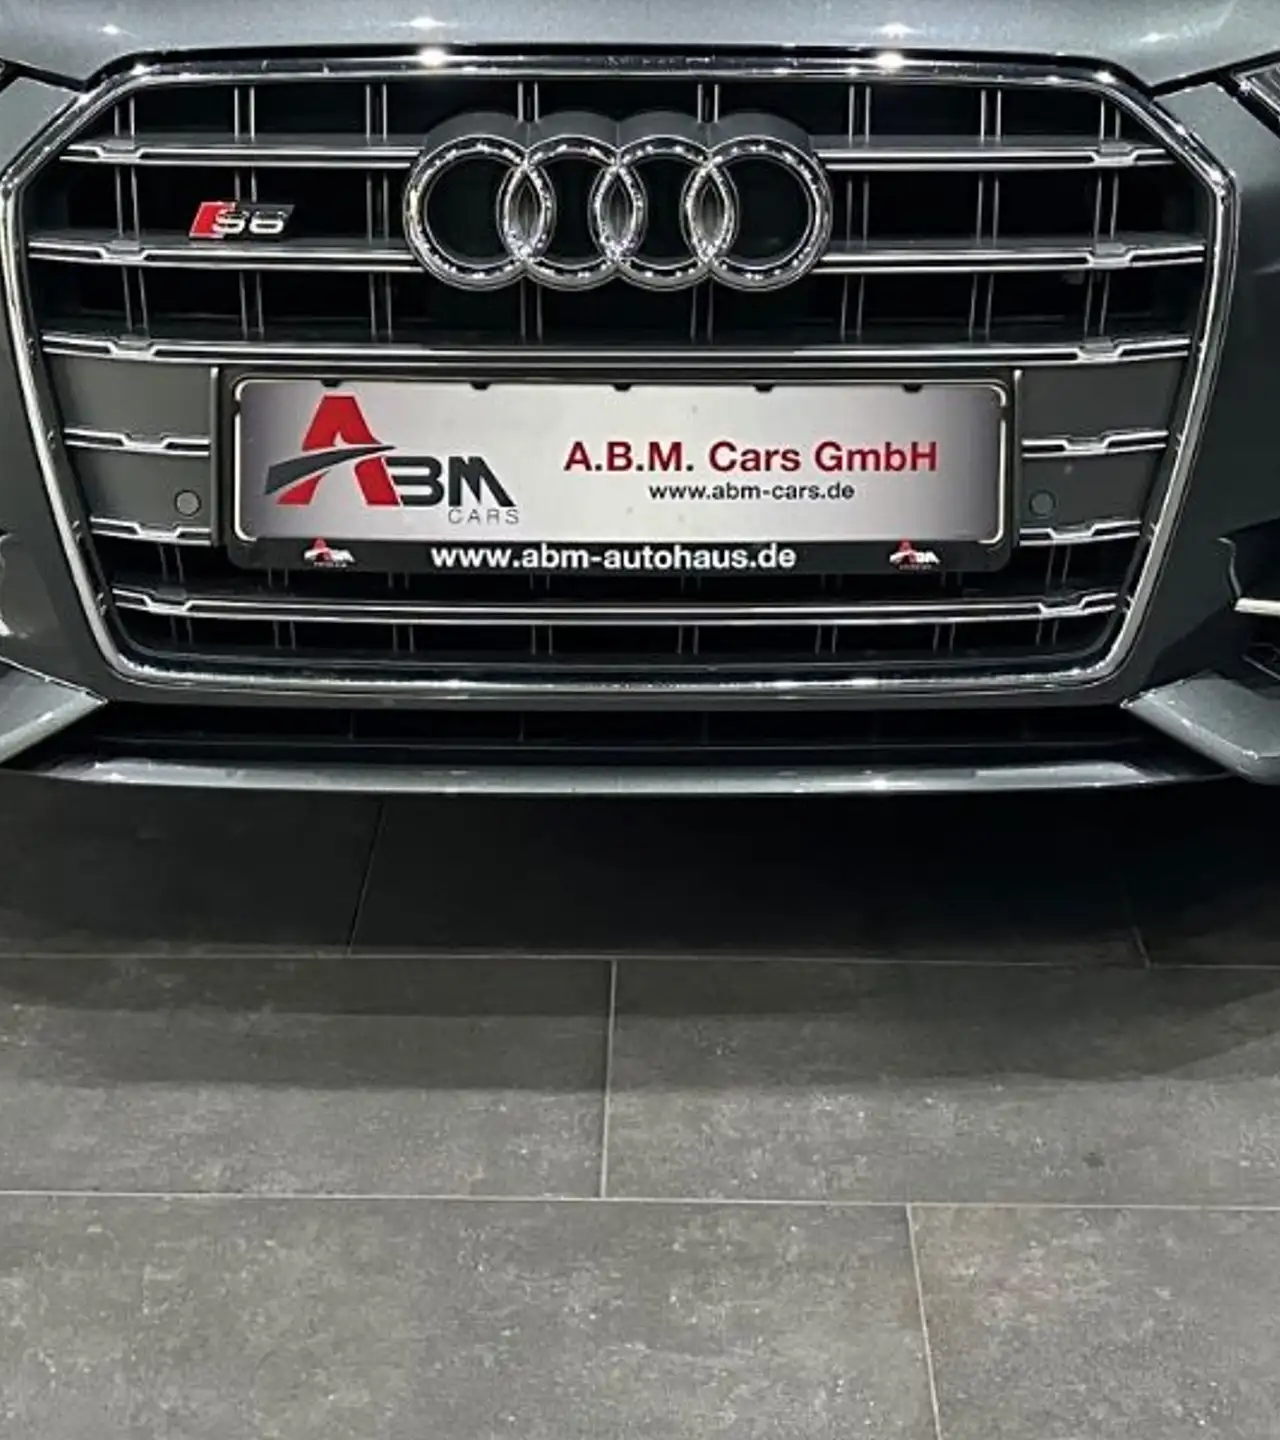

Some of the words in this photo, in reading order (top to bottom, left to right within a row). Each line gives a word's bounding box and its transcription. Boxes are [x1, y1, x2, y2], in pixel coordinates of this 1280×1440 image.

[211, 207, 289, 235] S6
[265, 394, 517, 508] ABM
[563, 440, 695, 473] A.B.M.
[708, 440, 802, 474] Cars
[813, 440, 939, 473] GmbH
[648, 480, 856, 501] www.abm-cars.de
[447, 508, 521, 526] CARS
[430, 541, 798, 570] www.abm-autohaus.de
